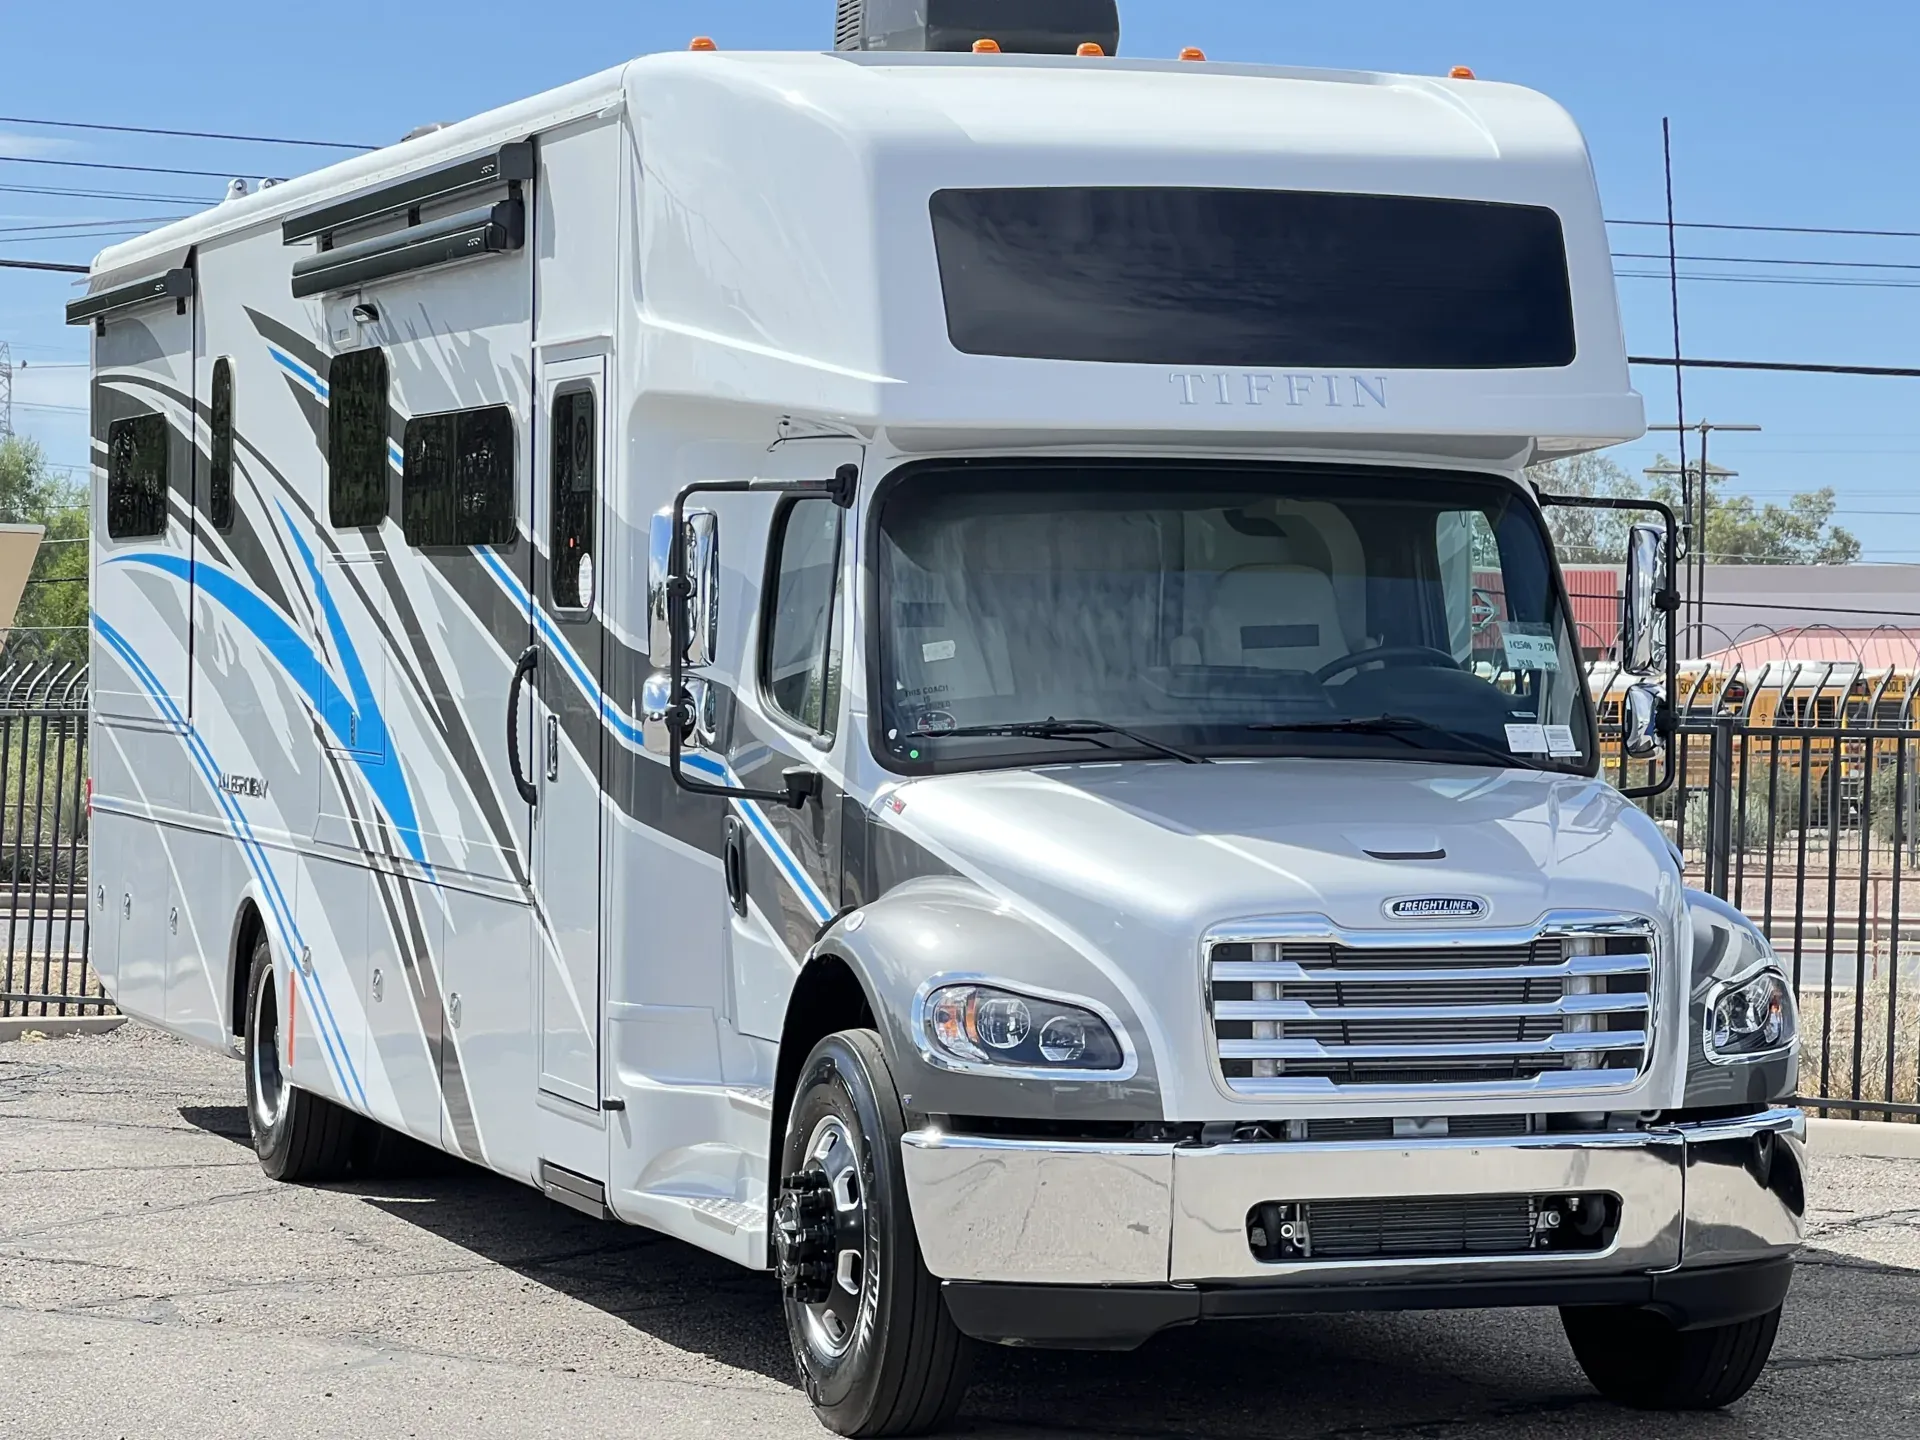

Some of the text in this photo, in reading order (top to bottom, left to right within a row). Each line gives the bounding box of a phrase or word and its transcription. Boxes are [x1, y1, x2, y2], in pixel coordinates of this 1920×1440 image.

[1169, 372, 1387, 408] TIFFIN
[923, 685, 948, 695] COACH
[1399, 900, 1473, 911] FREIGHTLINER
